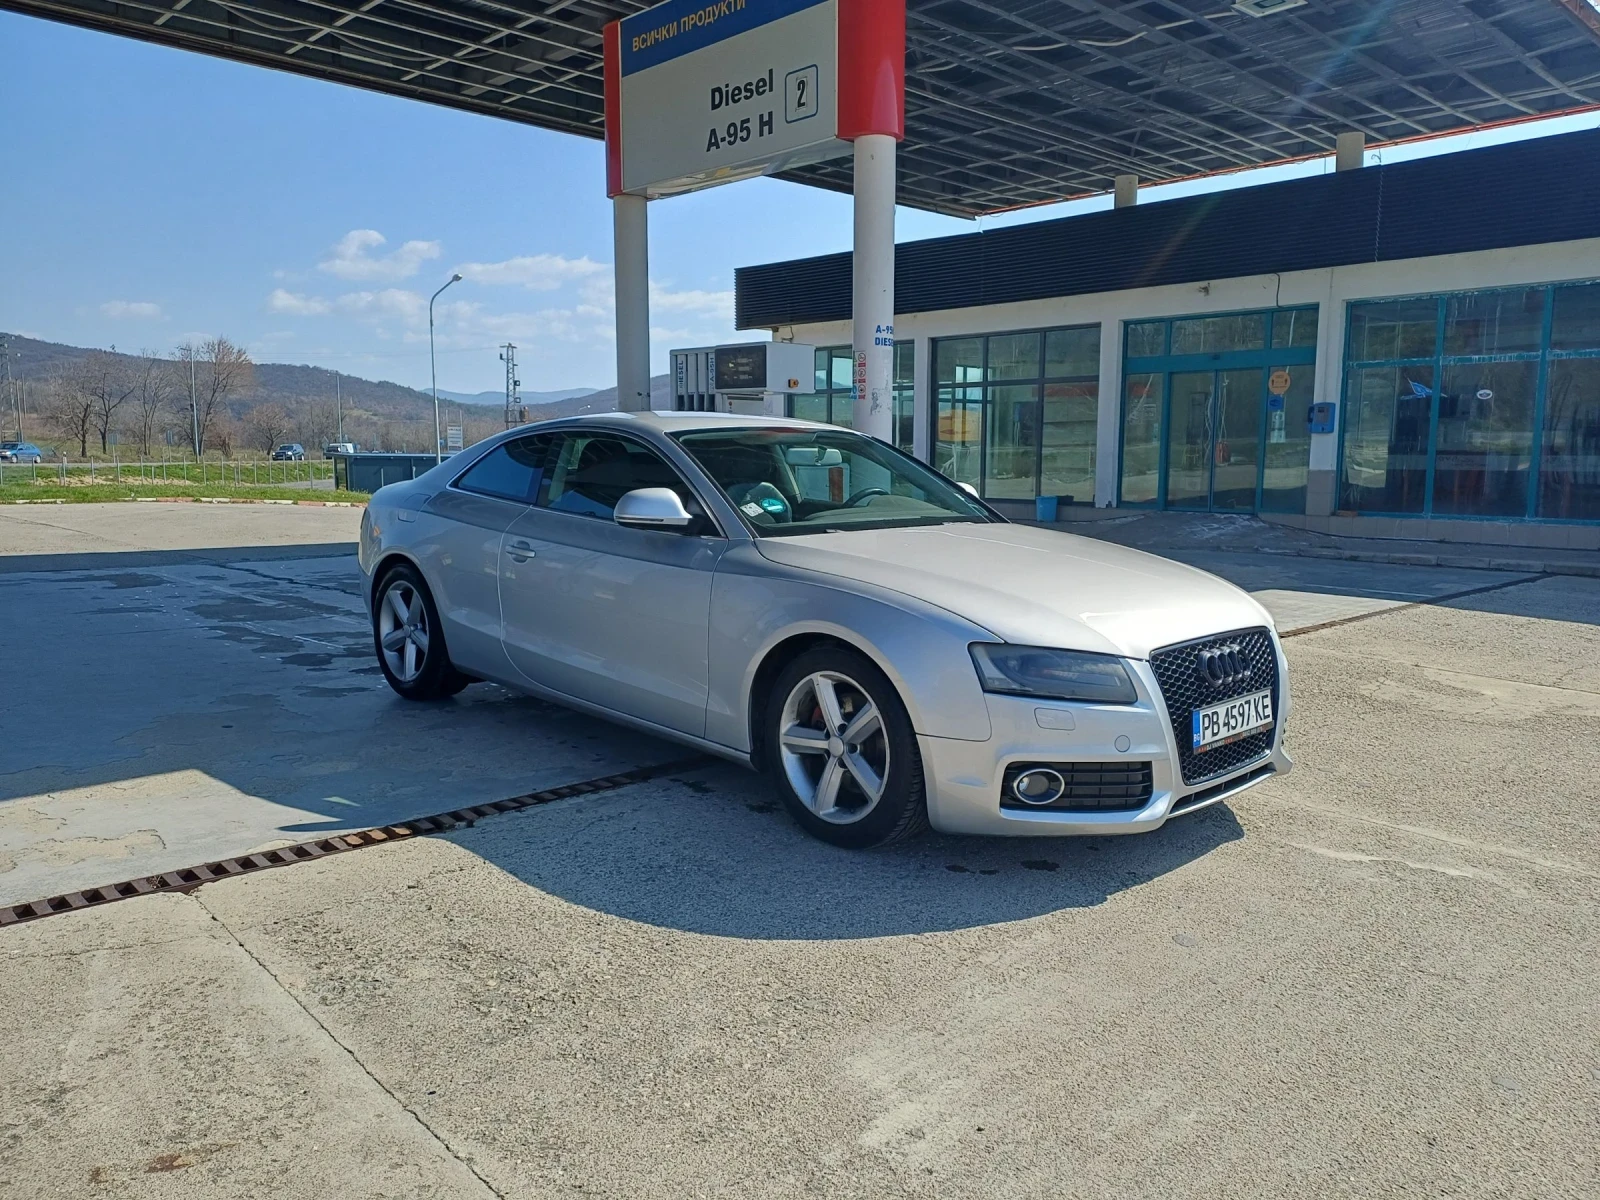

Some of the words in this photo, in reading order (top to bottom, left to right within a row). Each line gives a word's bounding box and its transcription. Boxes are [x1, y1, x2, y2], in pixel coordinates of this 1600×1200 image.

[632, 21, 677, 52] ВСИЧКИ
[680, 0, 746, 33] ПРОДУКТИ
[711, 68, 773, 111] Diesel
[797, 80, 806, 108] 2
[706, 117, 751, 152] A-95
[759, 111, 773, 137] H
[1193, 733, 1200, 742] BG
[1202, 710, 1220, 741] PB
[1222, 700, 1251, 733] 4597
[1254, 694, 1271, 723] KE
